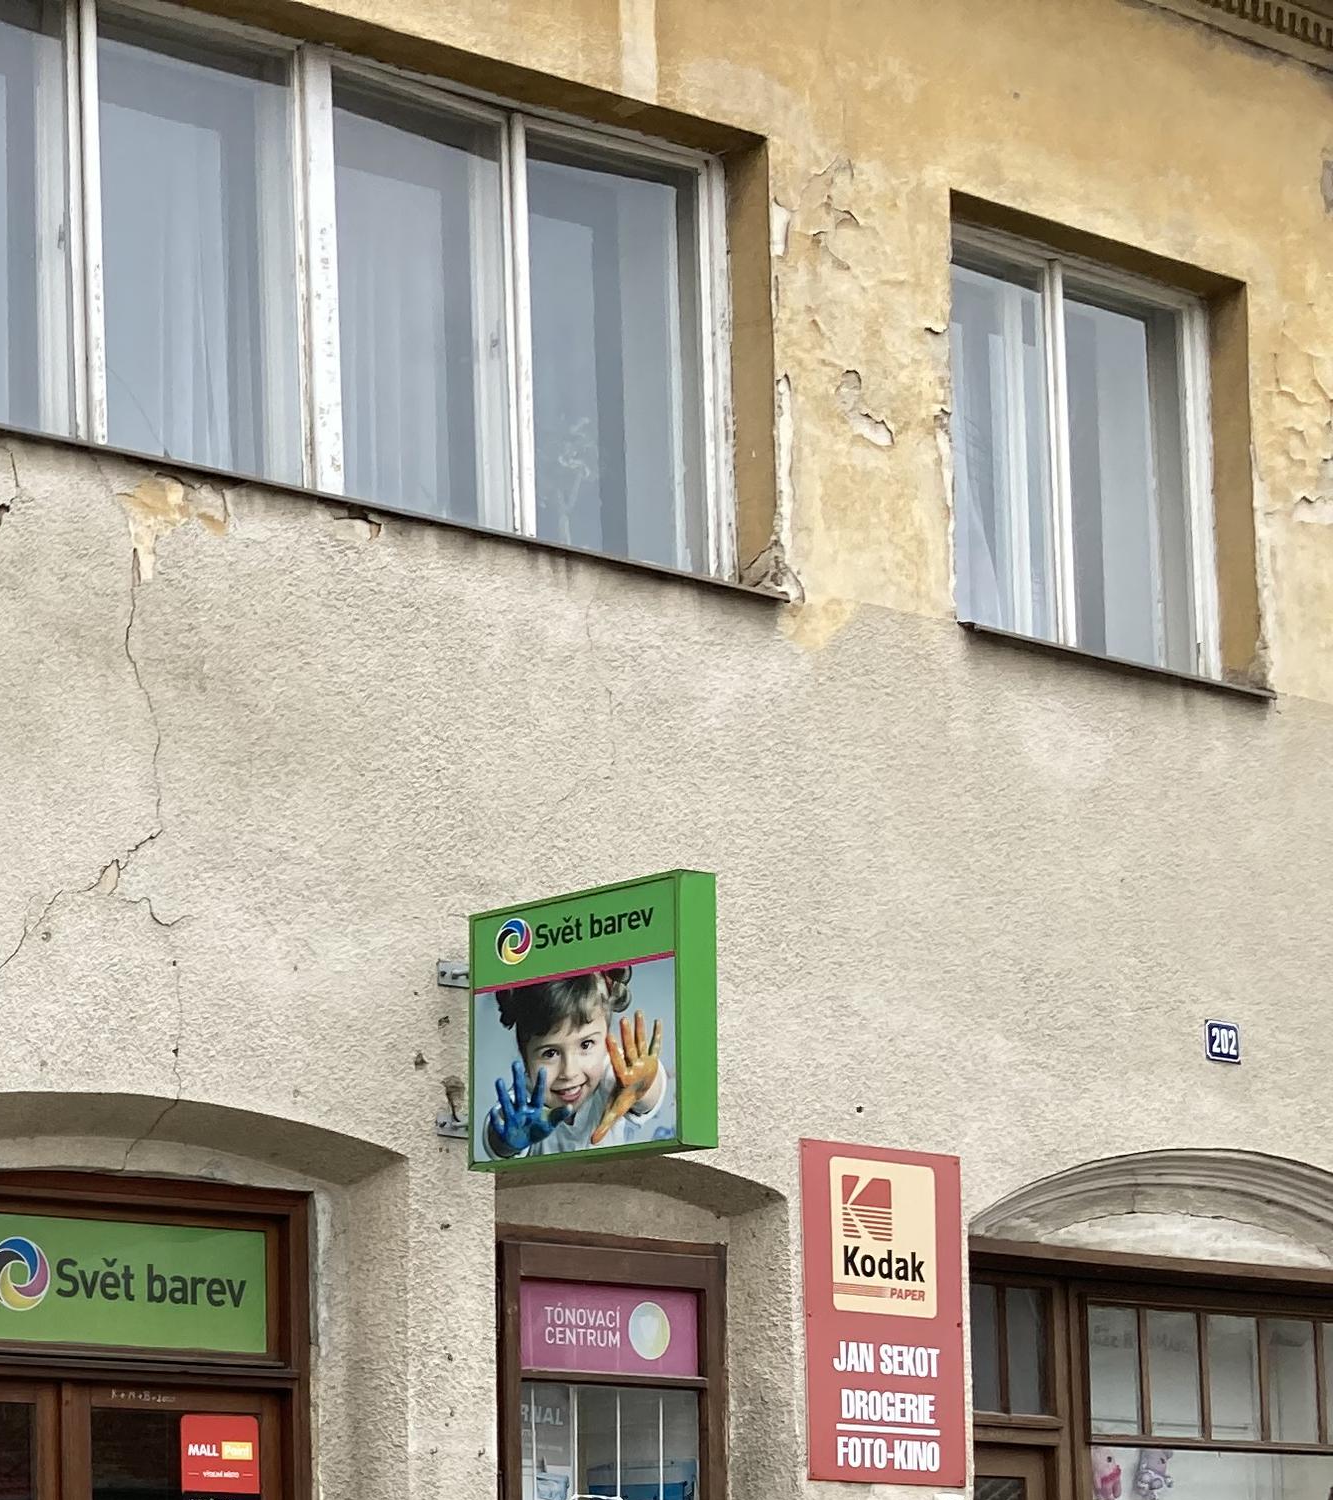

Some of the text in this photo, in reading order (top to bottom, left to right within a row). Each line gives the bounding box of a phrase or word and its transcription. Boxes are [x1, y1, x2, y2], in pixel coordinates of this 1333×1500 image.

[535, 907, 654, 950] Svět barev
[1212, 1027, 1237, 1055] 202
[56, 1257, 247, 1308] Svět barev
[843, 1245, 926, 1283] Kodak
[890, 1288, 926, 1302] PAPER
[544, 1302, 621, 1328] TÓNOVACÍ
[545, 1326, 621, 1349] CENTRUM
[833, 1341, 941, 1378] JAN SEKOT
[840, 1388, 936, 1425] DROGERIE
[188, 1444, 219, 1457] MALL
[836, 1436, 941, 1473] FOTO-KINO
